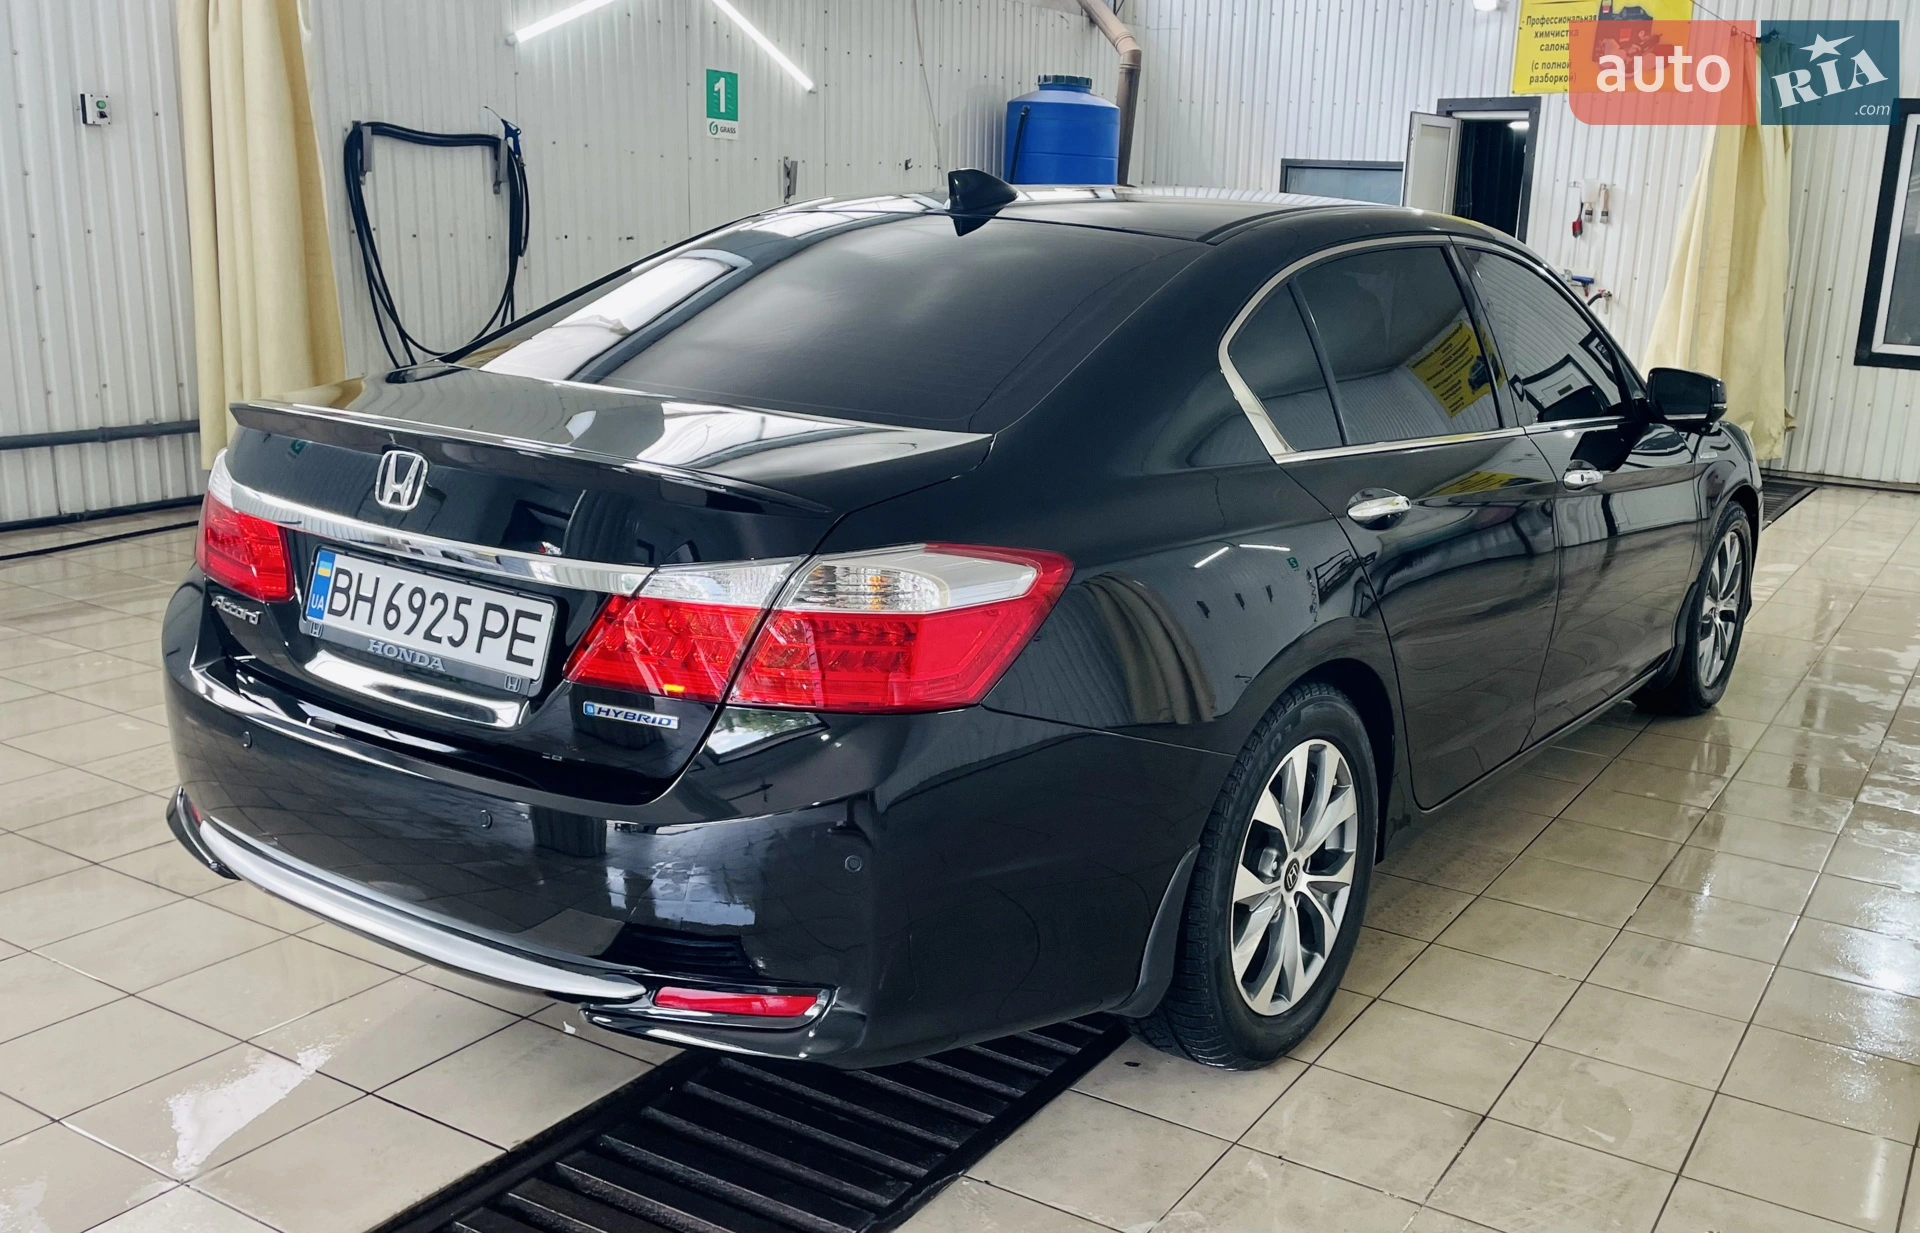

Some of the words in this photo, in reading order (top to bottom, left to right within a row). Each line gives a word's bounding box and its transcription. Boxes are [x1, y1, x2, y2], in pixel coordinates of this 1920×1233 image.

[1534, 29, 1579, 38] химчистка
[1539, 42, 1570, 52] салона
[713, 76, 726, 113] 1
[719, 126, 736, 134] GRASS
[211, 595, 263, 625] Accord
[310, 592, 325, 611] UA
[366, 639, 446, 673] HONDA
[597, 706, 672, 727] HYBRID
